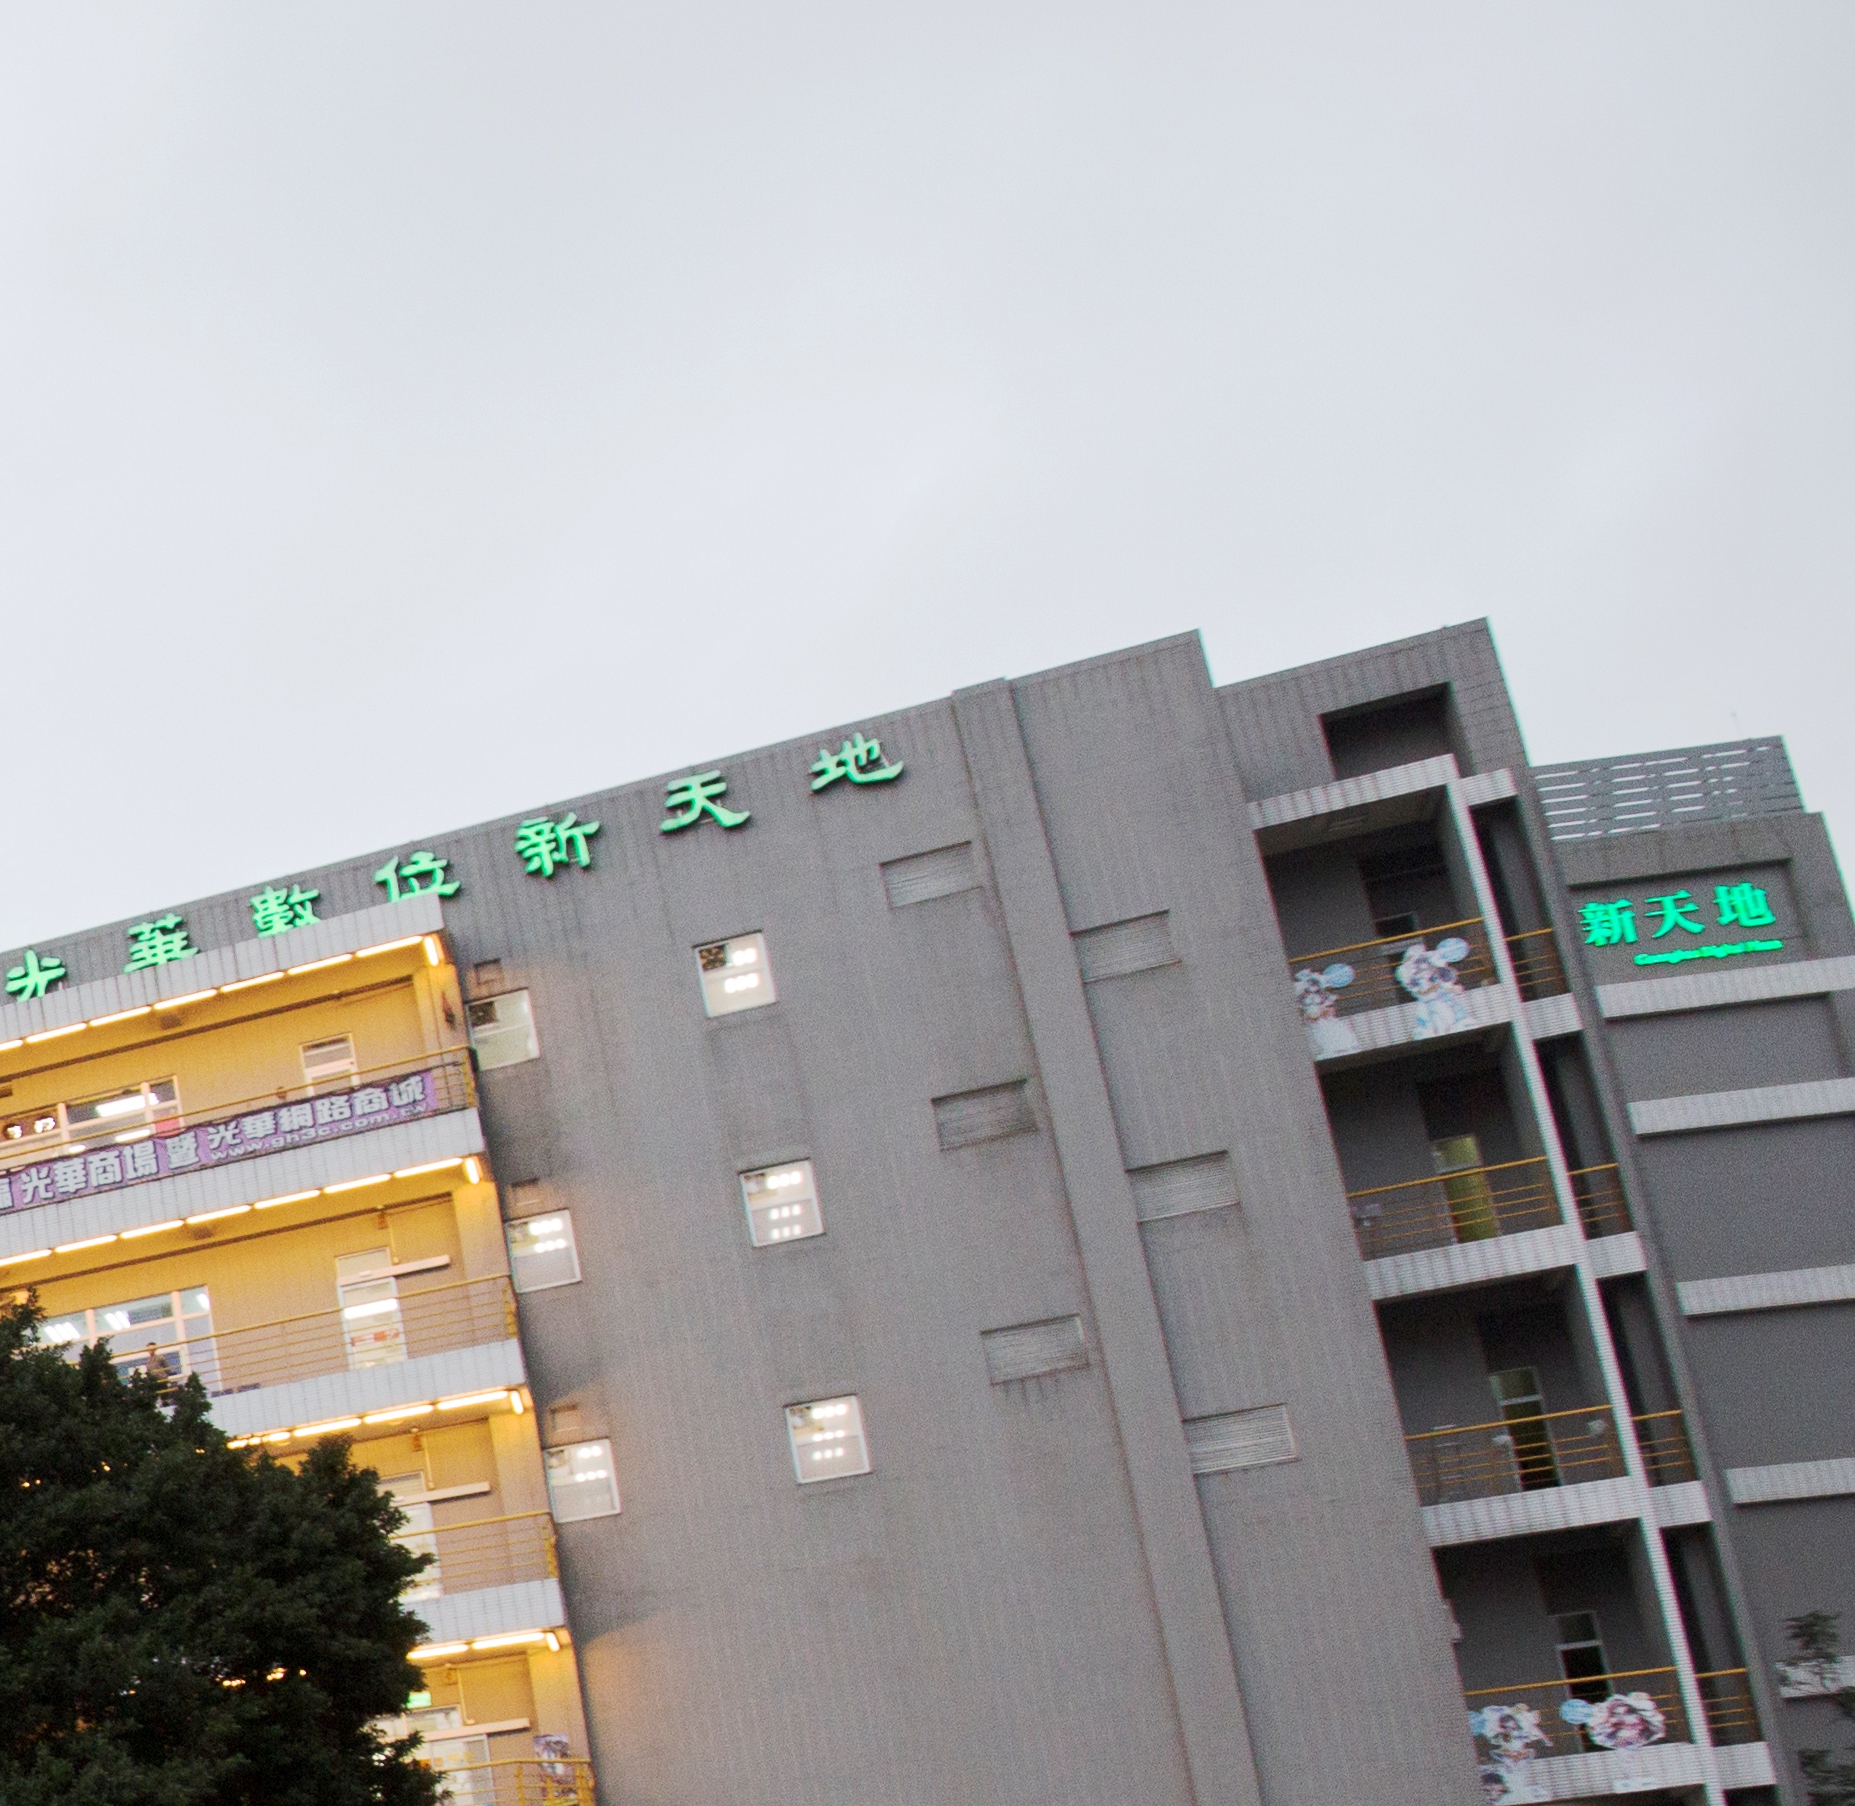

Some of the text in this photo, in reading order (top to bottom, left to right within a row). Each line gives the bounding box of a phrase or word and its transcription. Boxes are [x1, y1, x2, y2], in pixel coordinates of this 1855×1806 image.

[5, 733, 904, 1002] 光華數位新天地
[1577, 882, 1776, 946] 新天地
[21, 1139, 159, 1204] 光華商場
